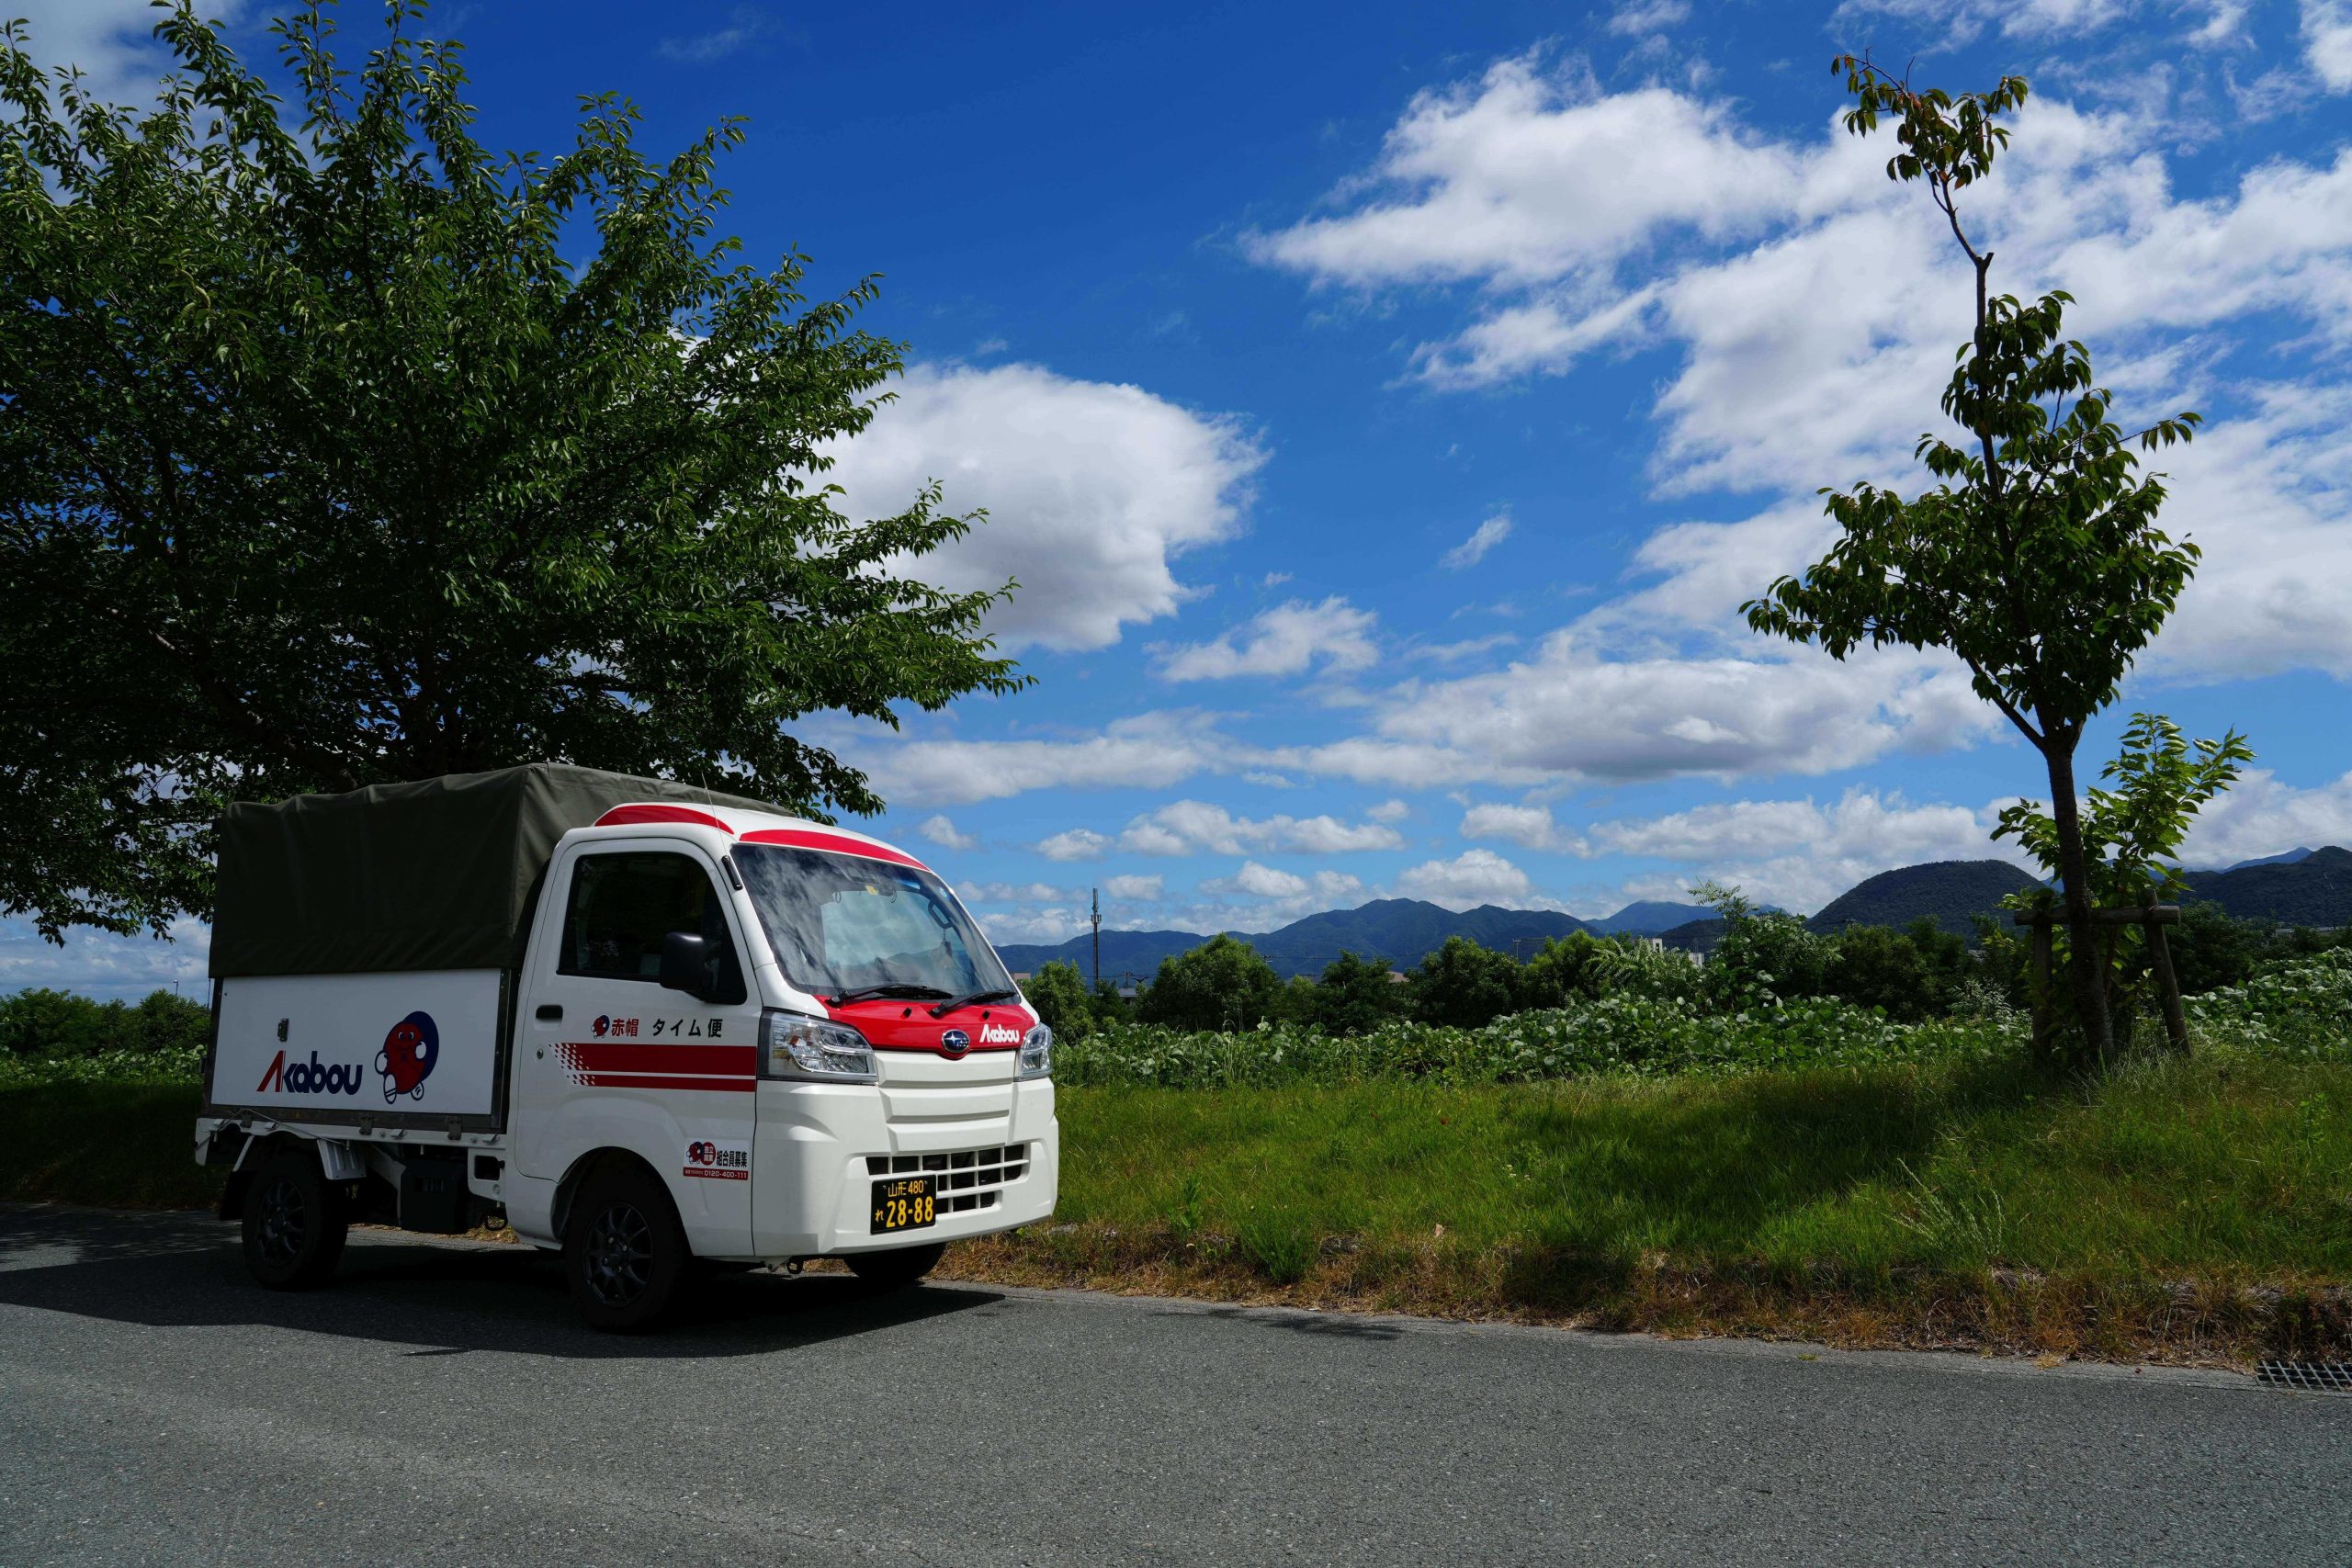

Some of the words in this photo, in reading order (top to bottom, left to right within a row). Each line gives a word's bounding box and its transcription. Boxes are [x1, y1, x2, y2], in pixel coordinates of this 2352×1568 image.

[611, 1018, 639, 1037] 赤帽
[652, 1018, 723, 1038] タイム便
[979, 1023, 1020, 1043] Akabou
[256, 1050, 363, 1096] Akabou
[888, 1181, 907, 1197] 山形
[908, 1179, 924, 1195] 480
[886, 1195, 933, 1228] 28-88
